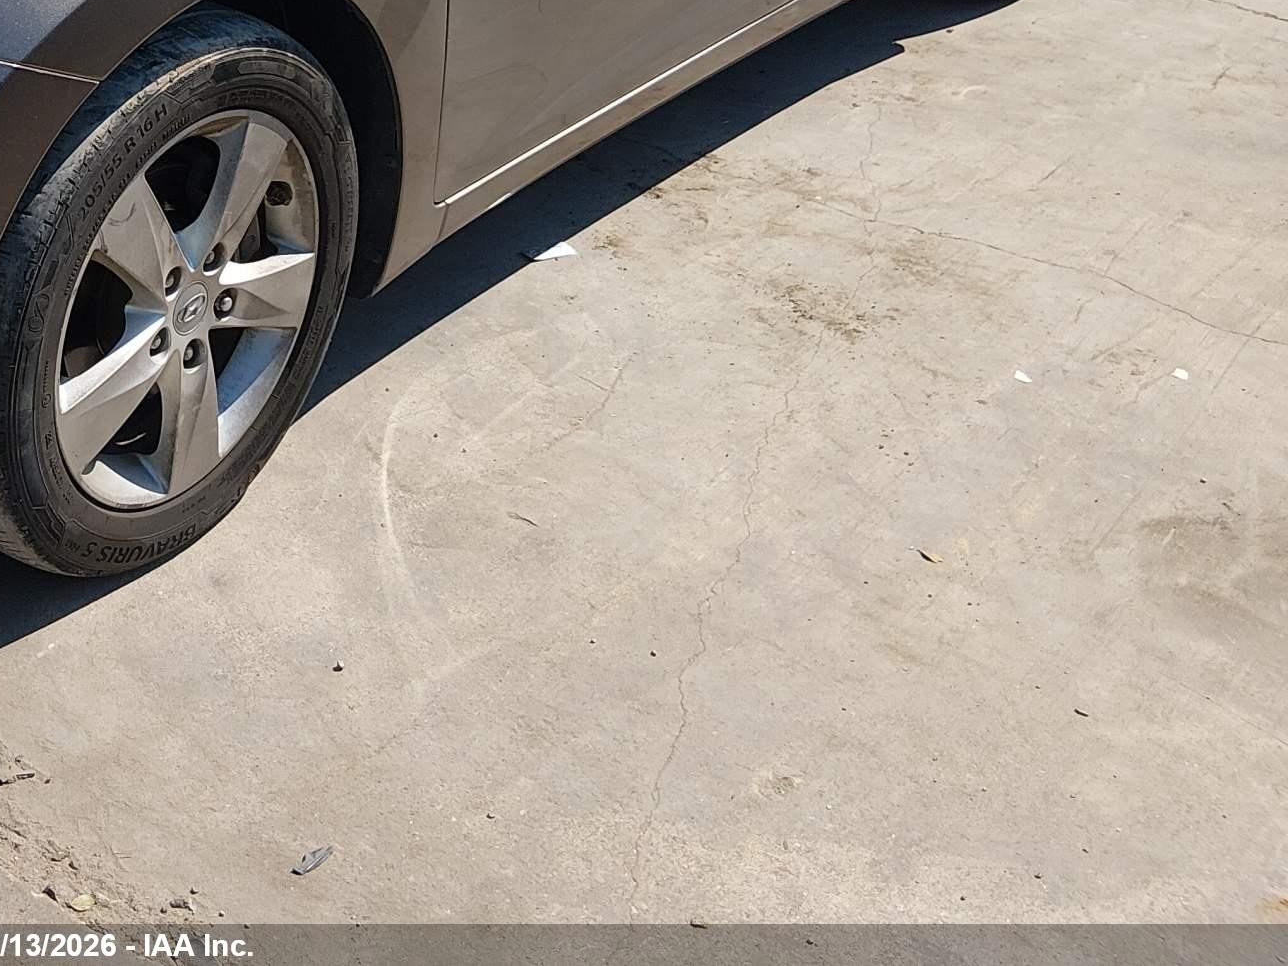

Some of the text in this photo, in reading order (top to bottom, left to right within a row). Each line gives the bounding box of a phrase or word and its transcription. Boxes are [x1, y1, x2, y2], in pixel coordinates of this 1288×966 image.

[76, 153, 123, 222] 205/55
[123, 135, 137, 155] R
[97, 523, 197, 563] BRAVURIS
